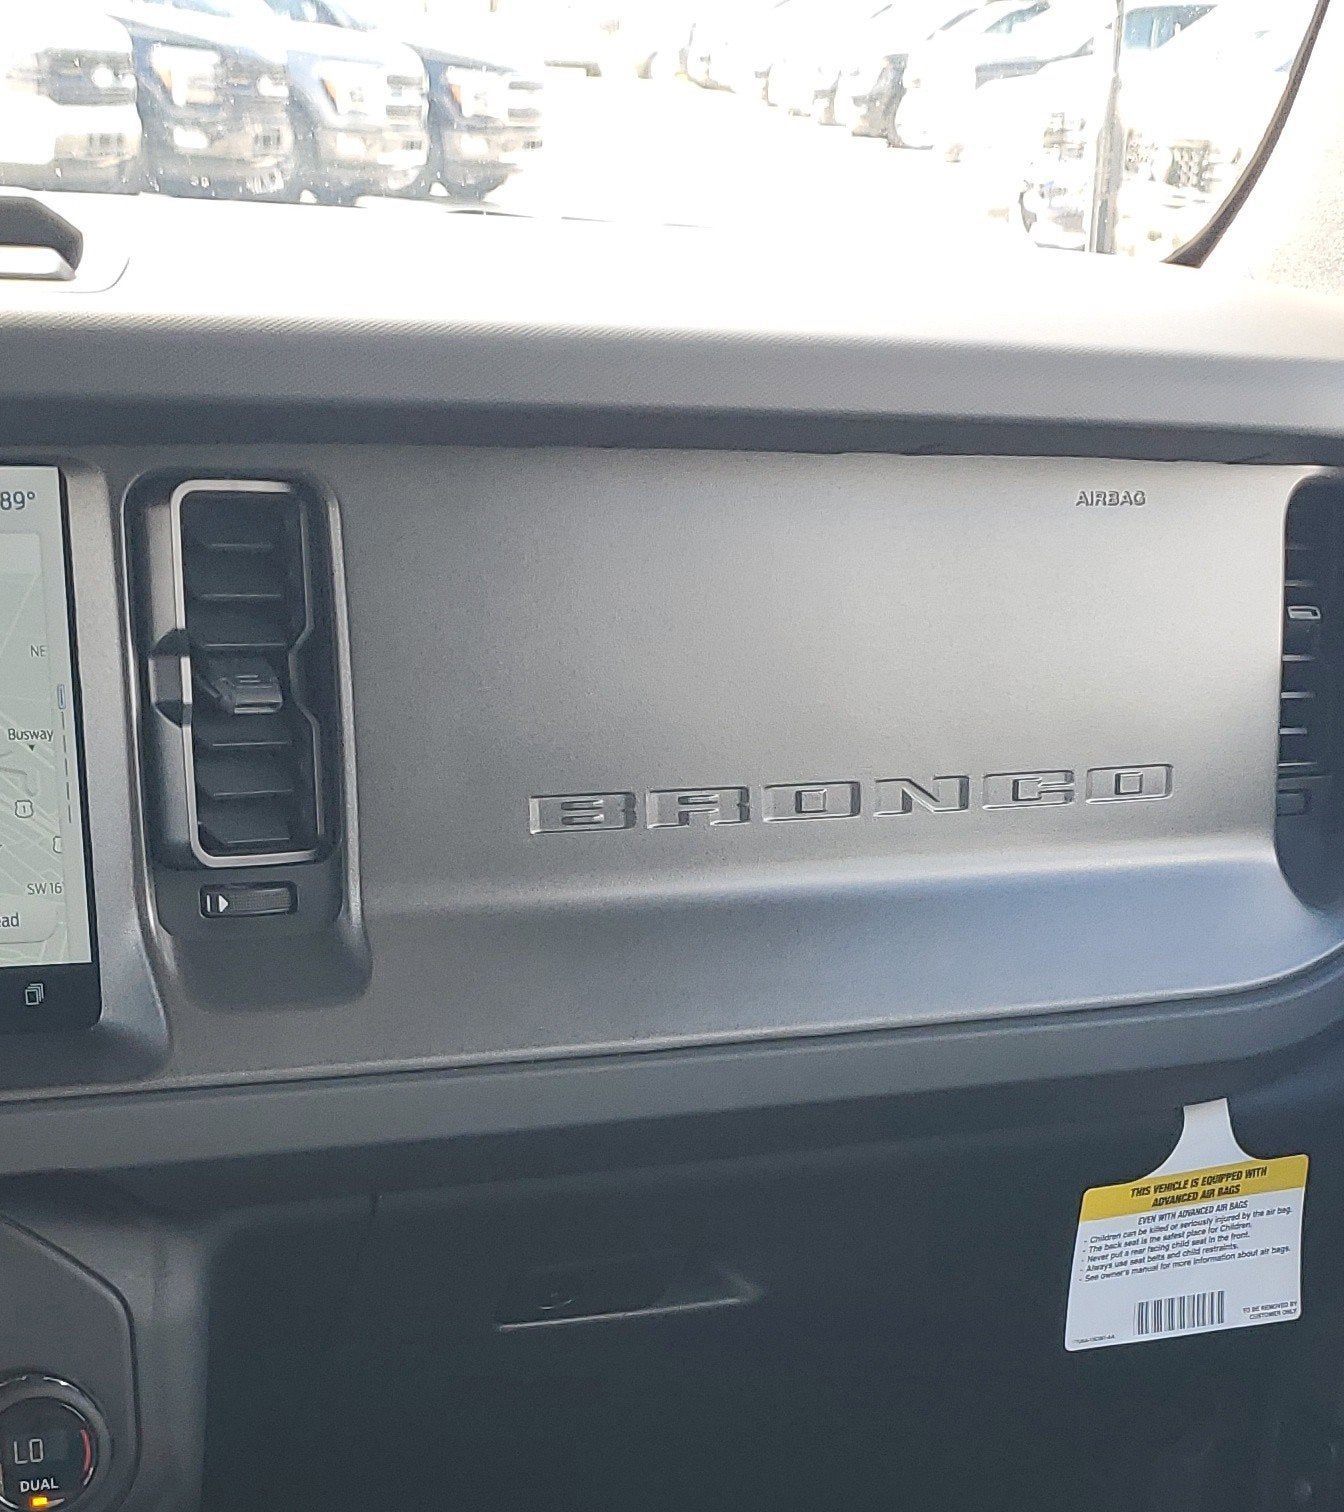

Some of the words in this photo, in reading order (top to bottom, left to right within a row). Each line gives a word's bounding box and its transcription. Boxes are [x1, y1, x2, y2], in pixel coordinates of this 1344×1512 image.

[0, 490, 36, 511] 89°
[1074, 490, 1147, 507] AIRBAG
[7, 727, 55, 744] Busway
[529, 763, 1174, 834] BRONCO
[27, 882, 47, 896] SW
[1130, 1186, 1151, 1198] THIS
[1153, 1179, 1189, 1195] VEHICLE
[1190, 1177, 1199, 1189] IS
[1201, 1170, 1243, 1186] EQUIPPED
[1244, 1166, 1268, 1179] WITH
[1152, 1191, 1199, 1207] ADVANCED
[1200, 1188, 1216, 1199] AIR
[1217, 1184, 1241, 1196] BAGS
[1138, 1215, 1157, 1226] EVEN
[1158, 1211, 1176, 1221] WITH
[1177, 1206, 1214, 1219] ADVANCED
[1215, 1203, 1228, 1213] AIR
[1229, 1200, 1249, 1211] BAGS
[1090, 1233, 1122, 1243] Children
[1241, 1211, 1251, 1221] by
[1253, 1209, 1264, 1217] the
[1087, 1254, 1109, 1263] Never
[1171, 1239, 1190, 1250] child
[1089, 1245, 1102, 1253] The
[1186, 1228, 1206, 1239] place
[20, 1477, 59, 1493] DUAL
